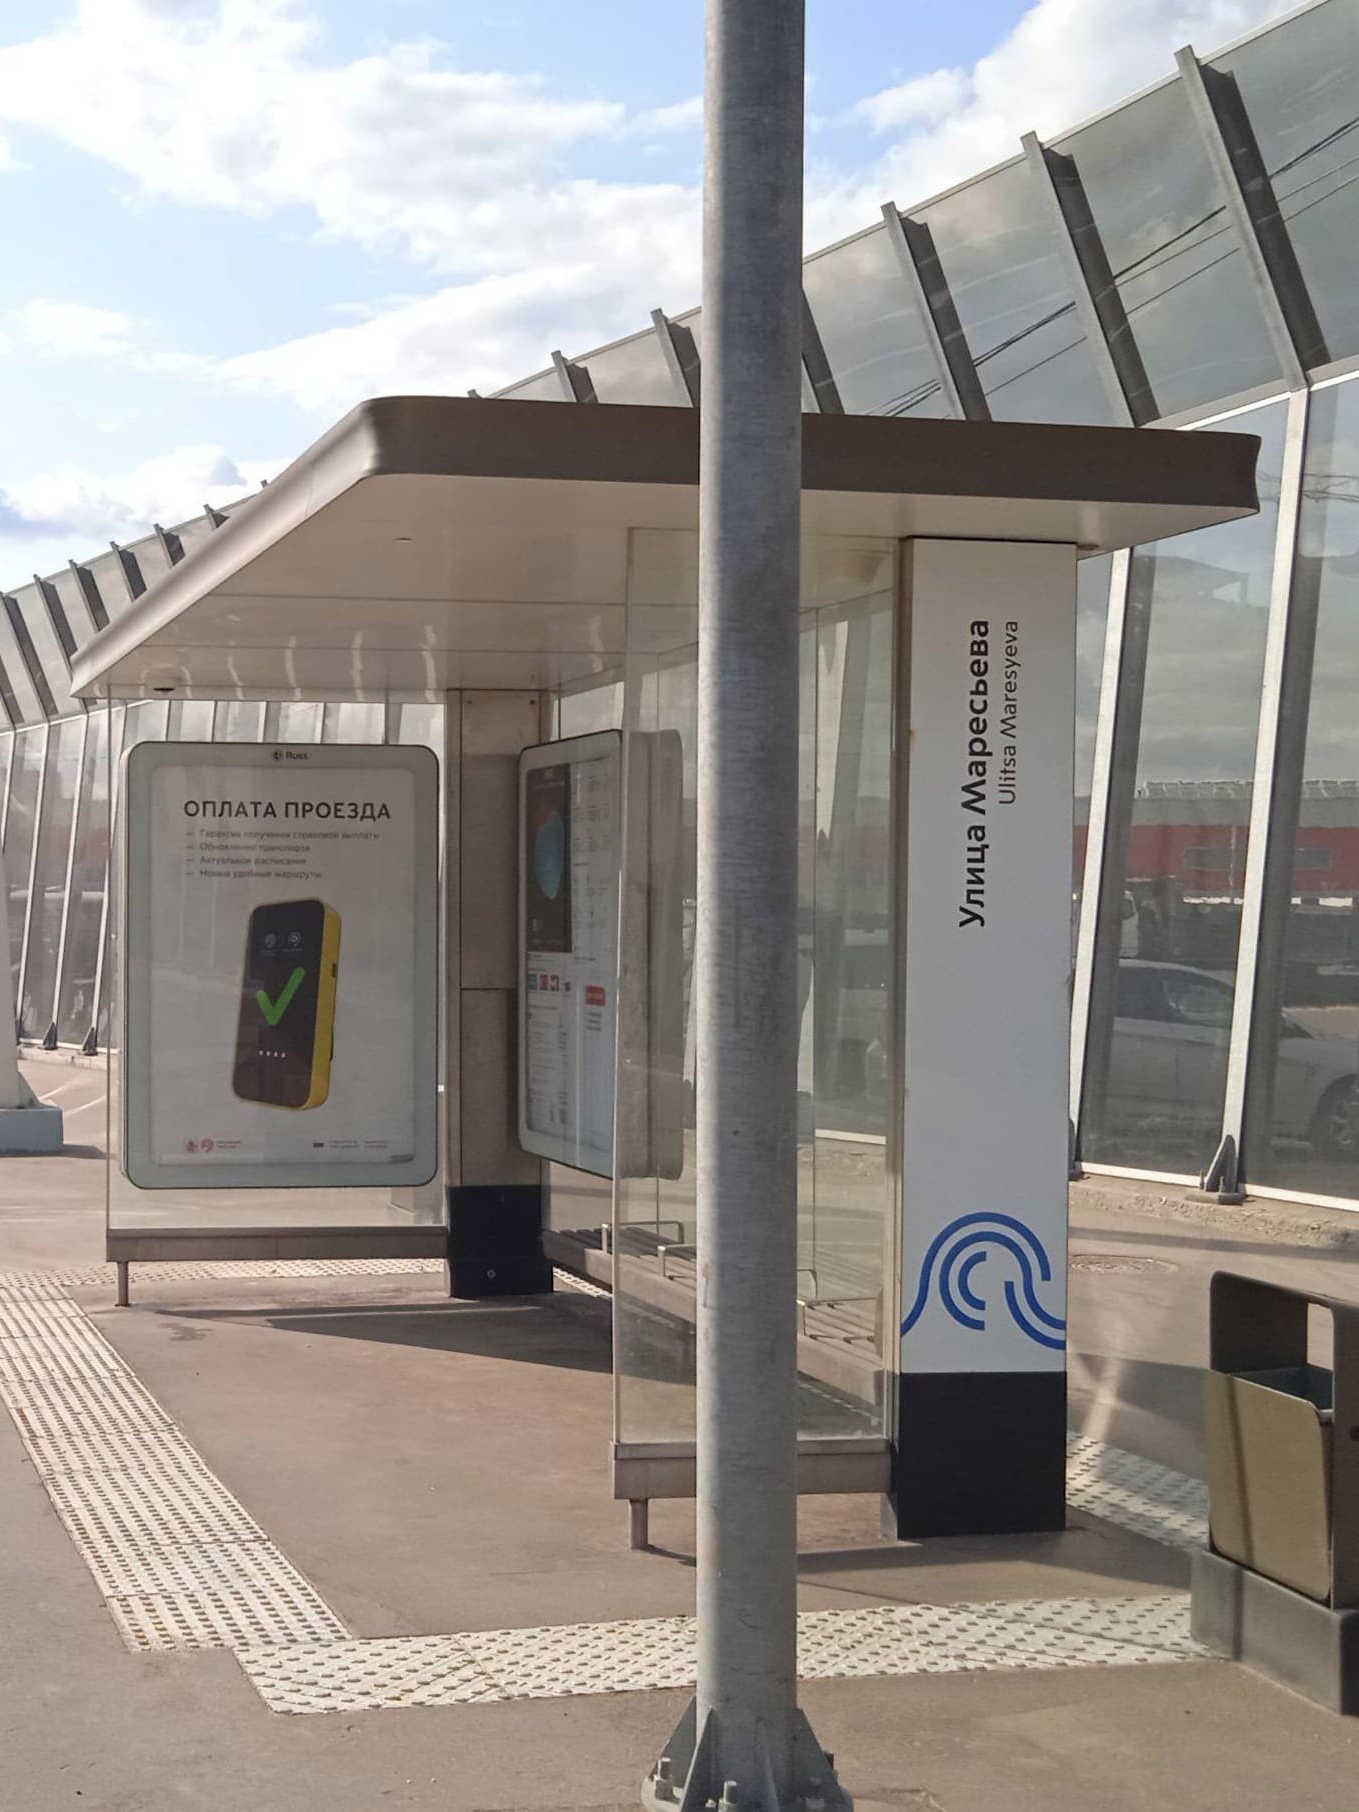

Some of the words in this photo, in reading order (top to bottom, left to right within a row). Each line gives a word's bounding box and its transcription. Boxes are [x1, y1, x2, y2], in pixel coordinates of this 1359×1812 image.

[960, 620, 993, 816] Маресьева
[999, 620, 1021, 740] Maresyeva
[183, 800, 277, 818] ОПЛАТА
[284, 801, 391, 822] ПРОЕЗДА
[998, 744, 1017, 805] Ulitsa
[959, 824, 990, 928] Улица
